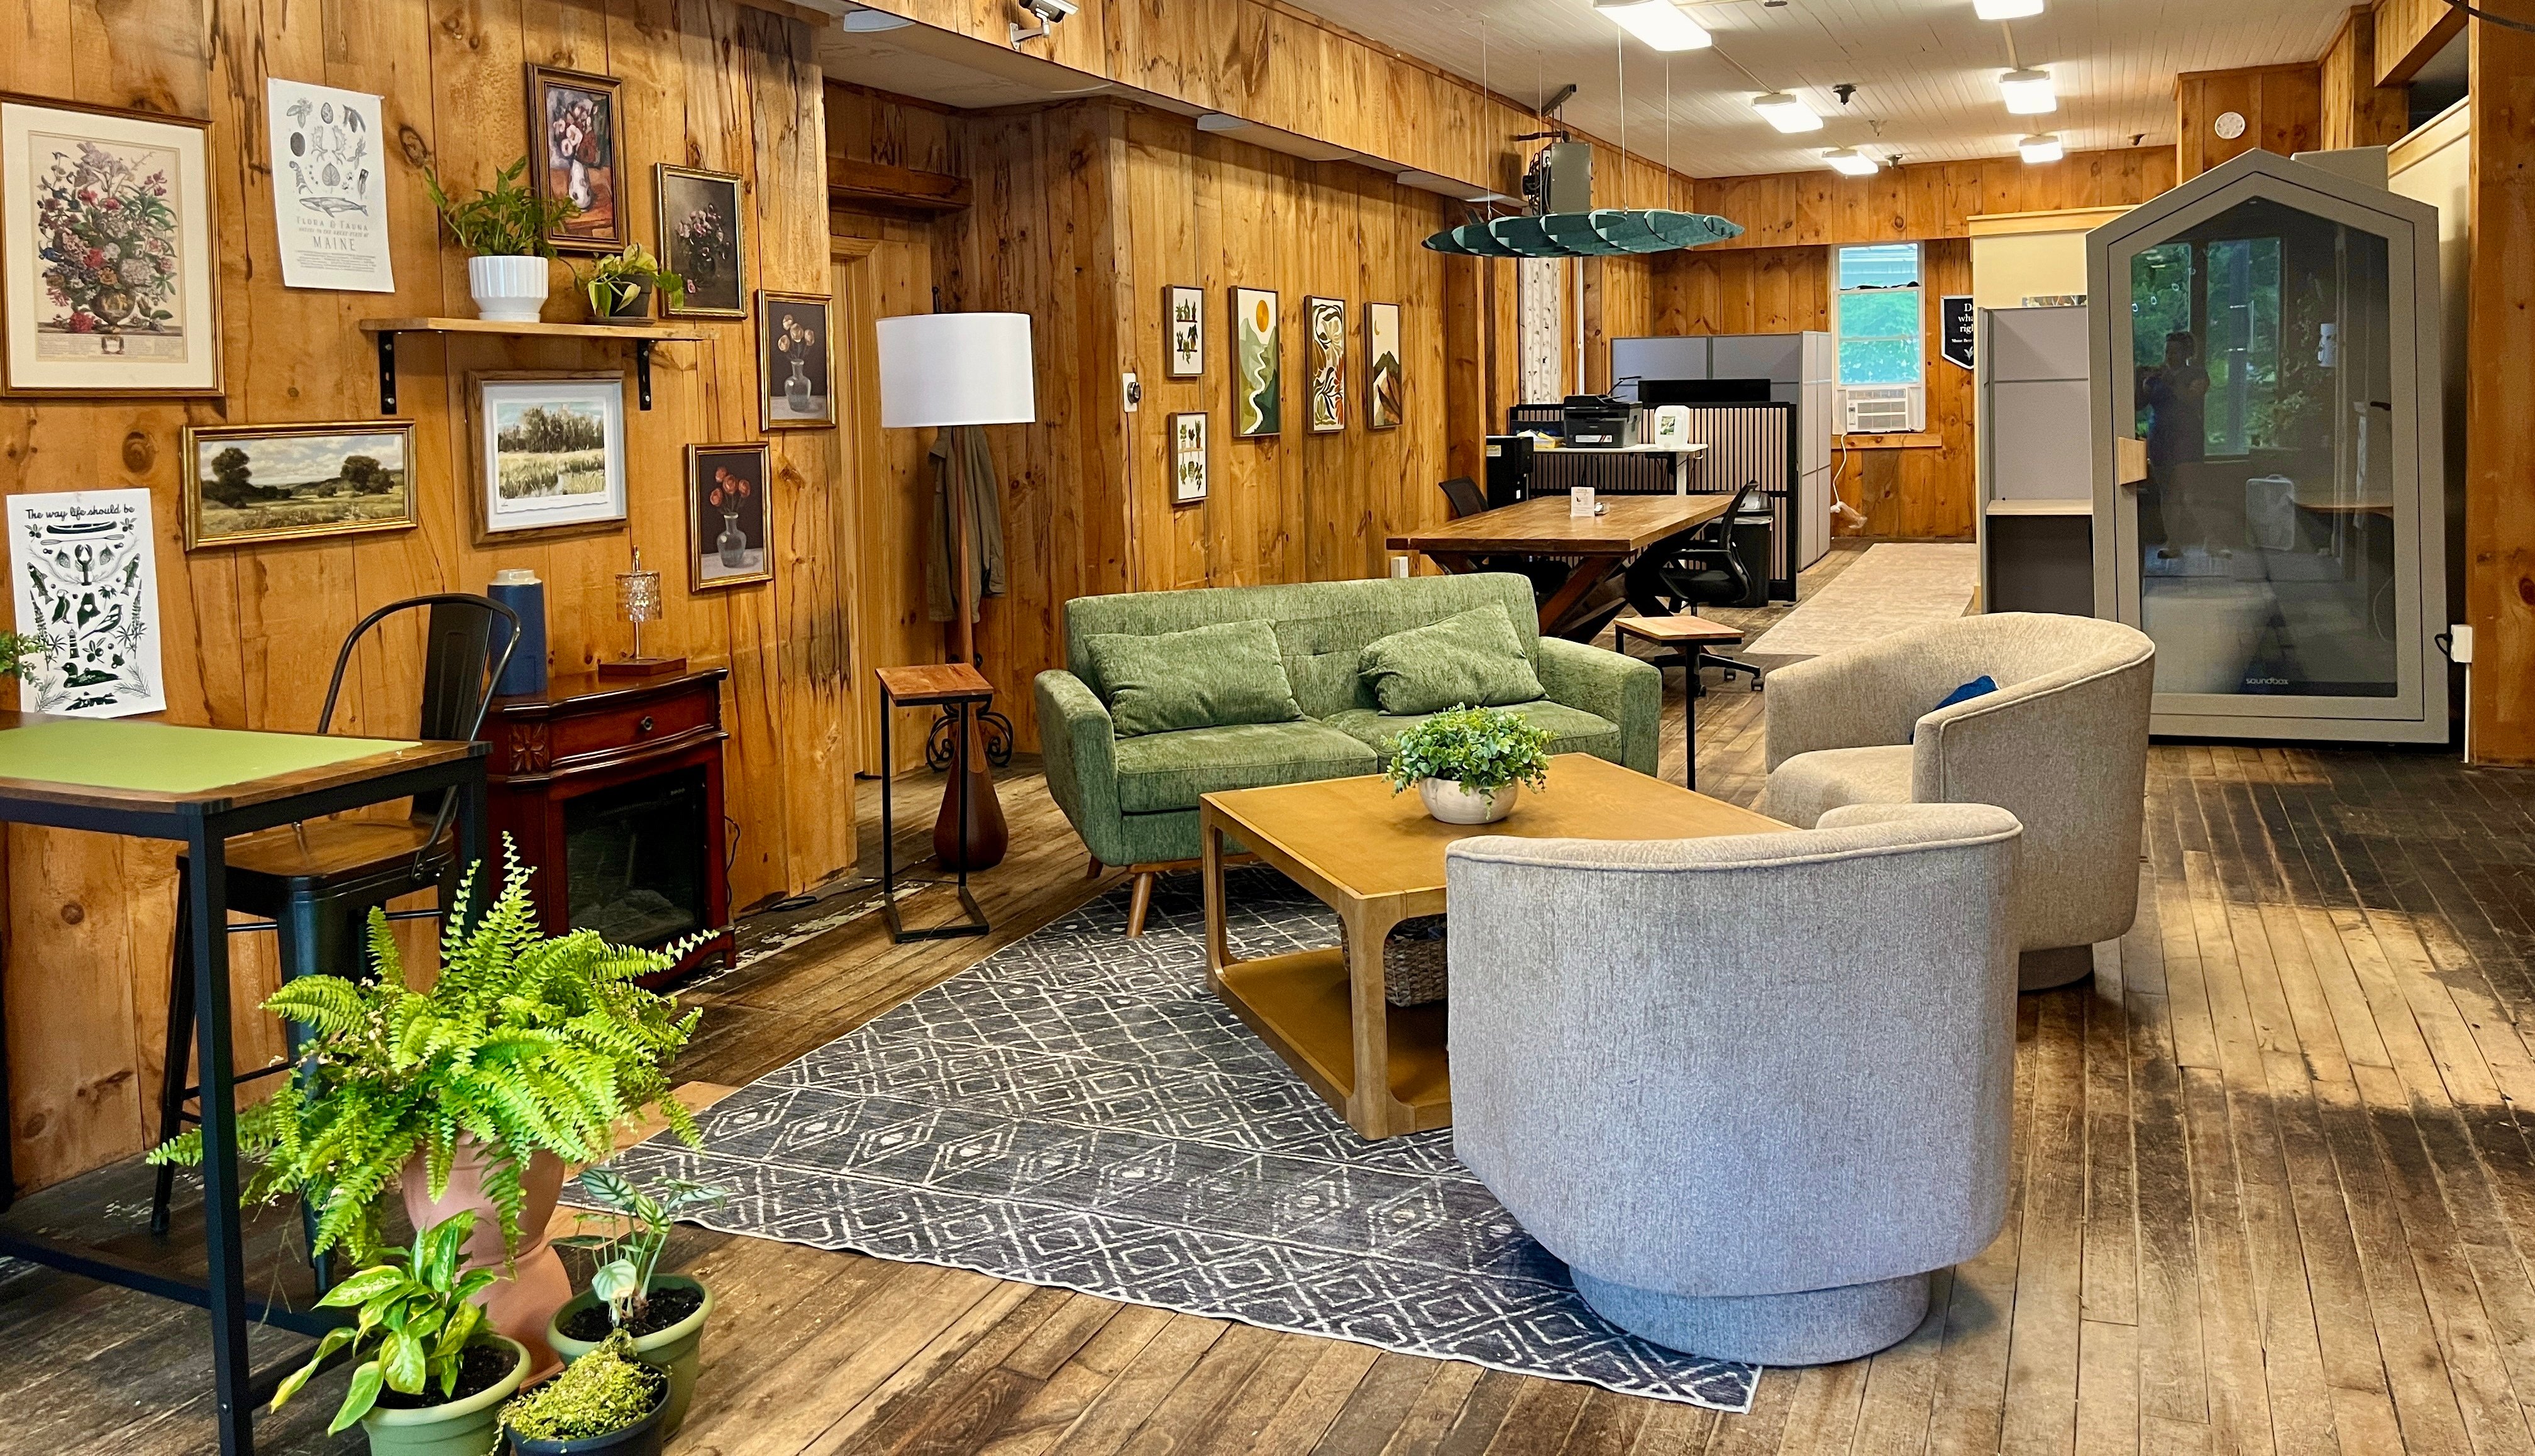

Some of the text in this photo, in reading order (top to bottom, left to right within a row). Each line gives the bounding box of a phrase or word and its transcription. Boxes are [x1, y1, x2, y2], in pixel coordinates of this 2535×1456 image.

[313, 236, 356, 251] MAINE
[1964, 303, 1974, 312] D
[25, 504, 135, 521] The way life should be
